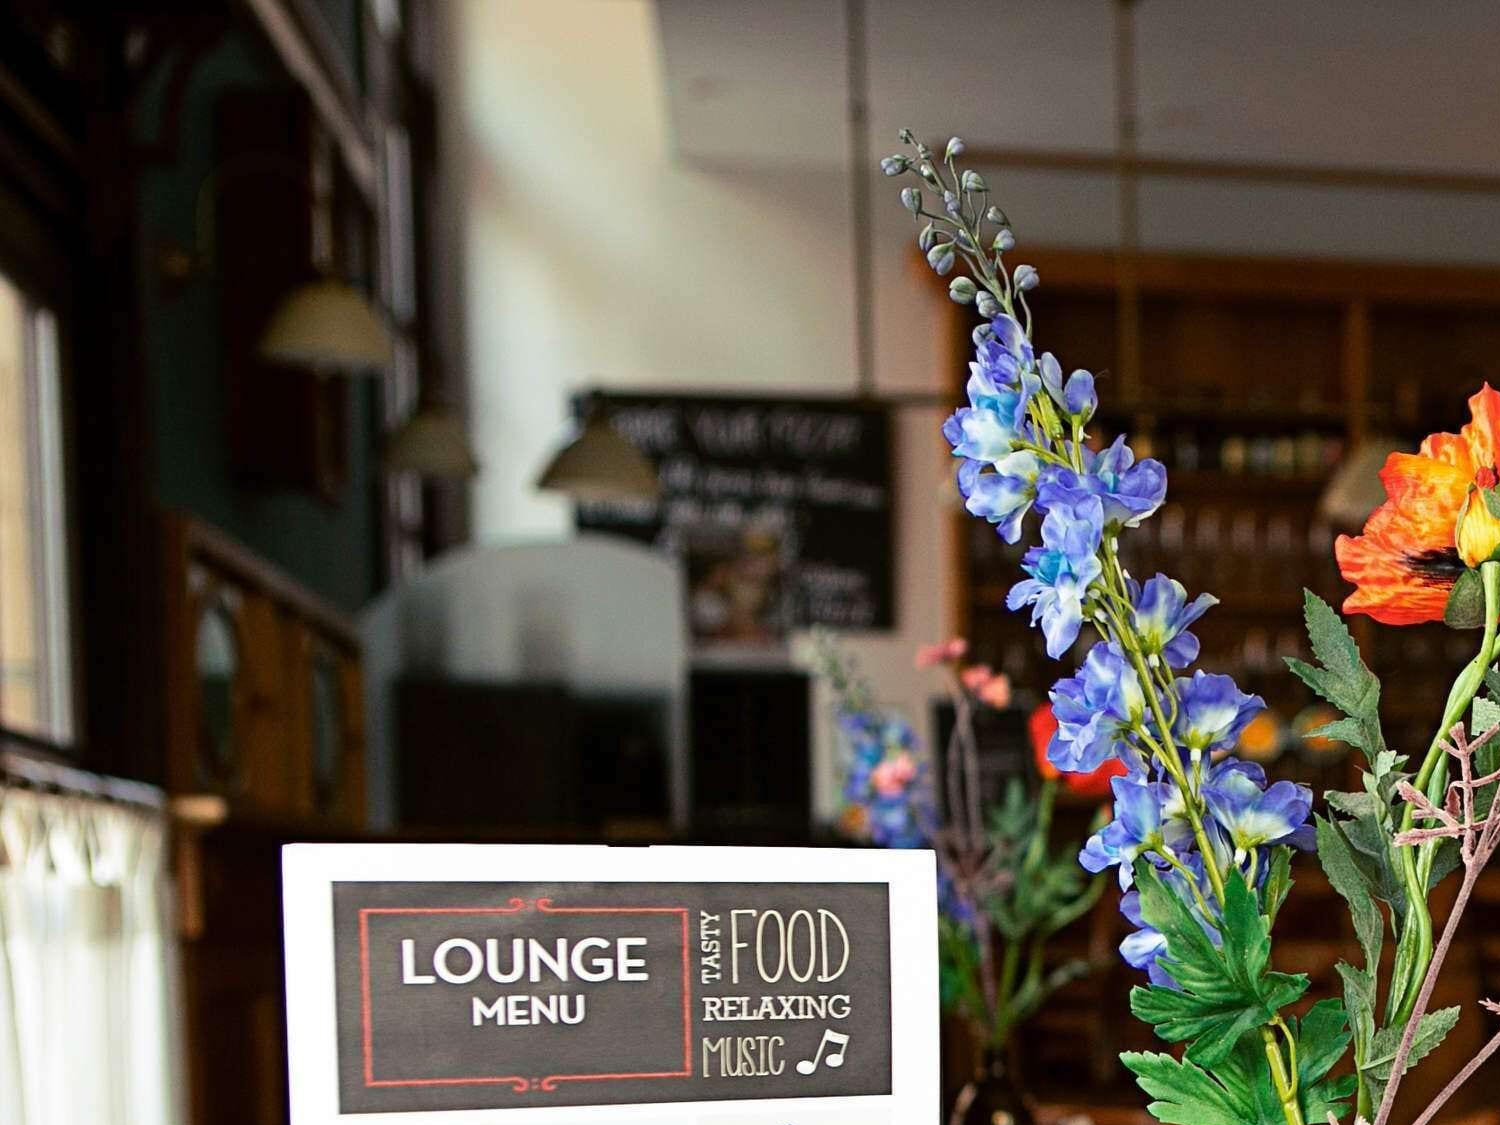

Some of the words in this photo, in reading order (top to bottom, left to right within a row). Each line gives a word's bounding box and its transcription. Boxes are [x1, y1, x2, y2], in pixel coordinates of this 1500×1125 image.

[402, 936, 650, 986] LOUNGE
[700, 910, 721, 984] TASTY
[730, 908, 850, 984] FOOD
[472, 994, 587, 1027] MENU
[702, 994, 851, 1022] RELAXING
[702, 1035, 786, 1078] MUSIC
